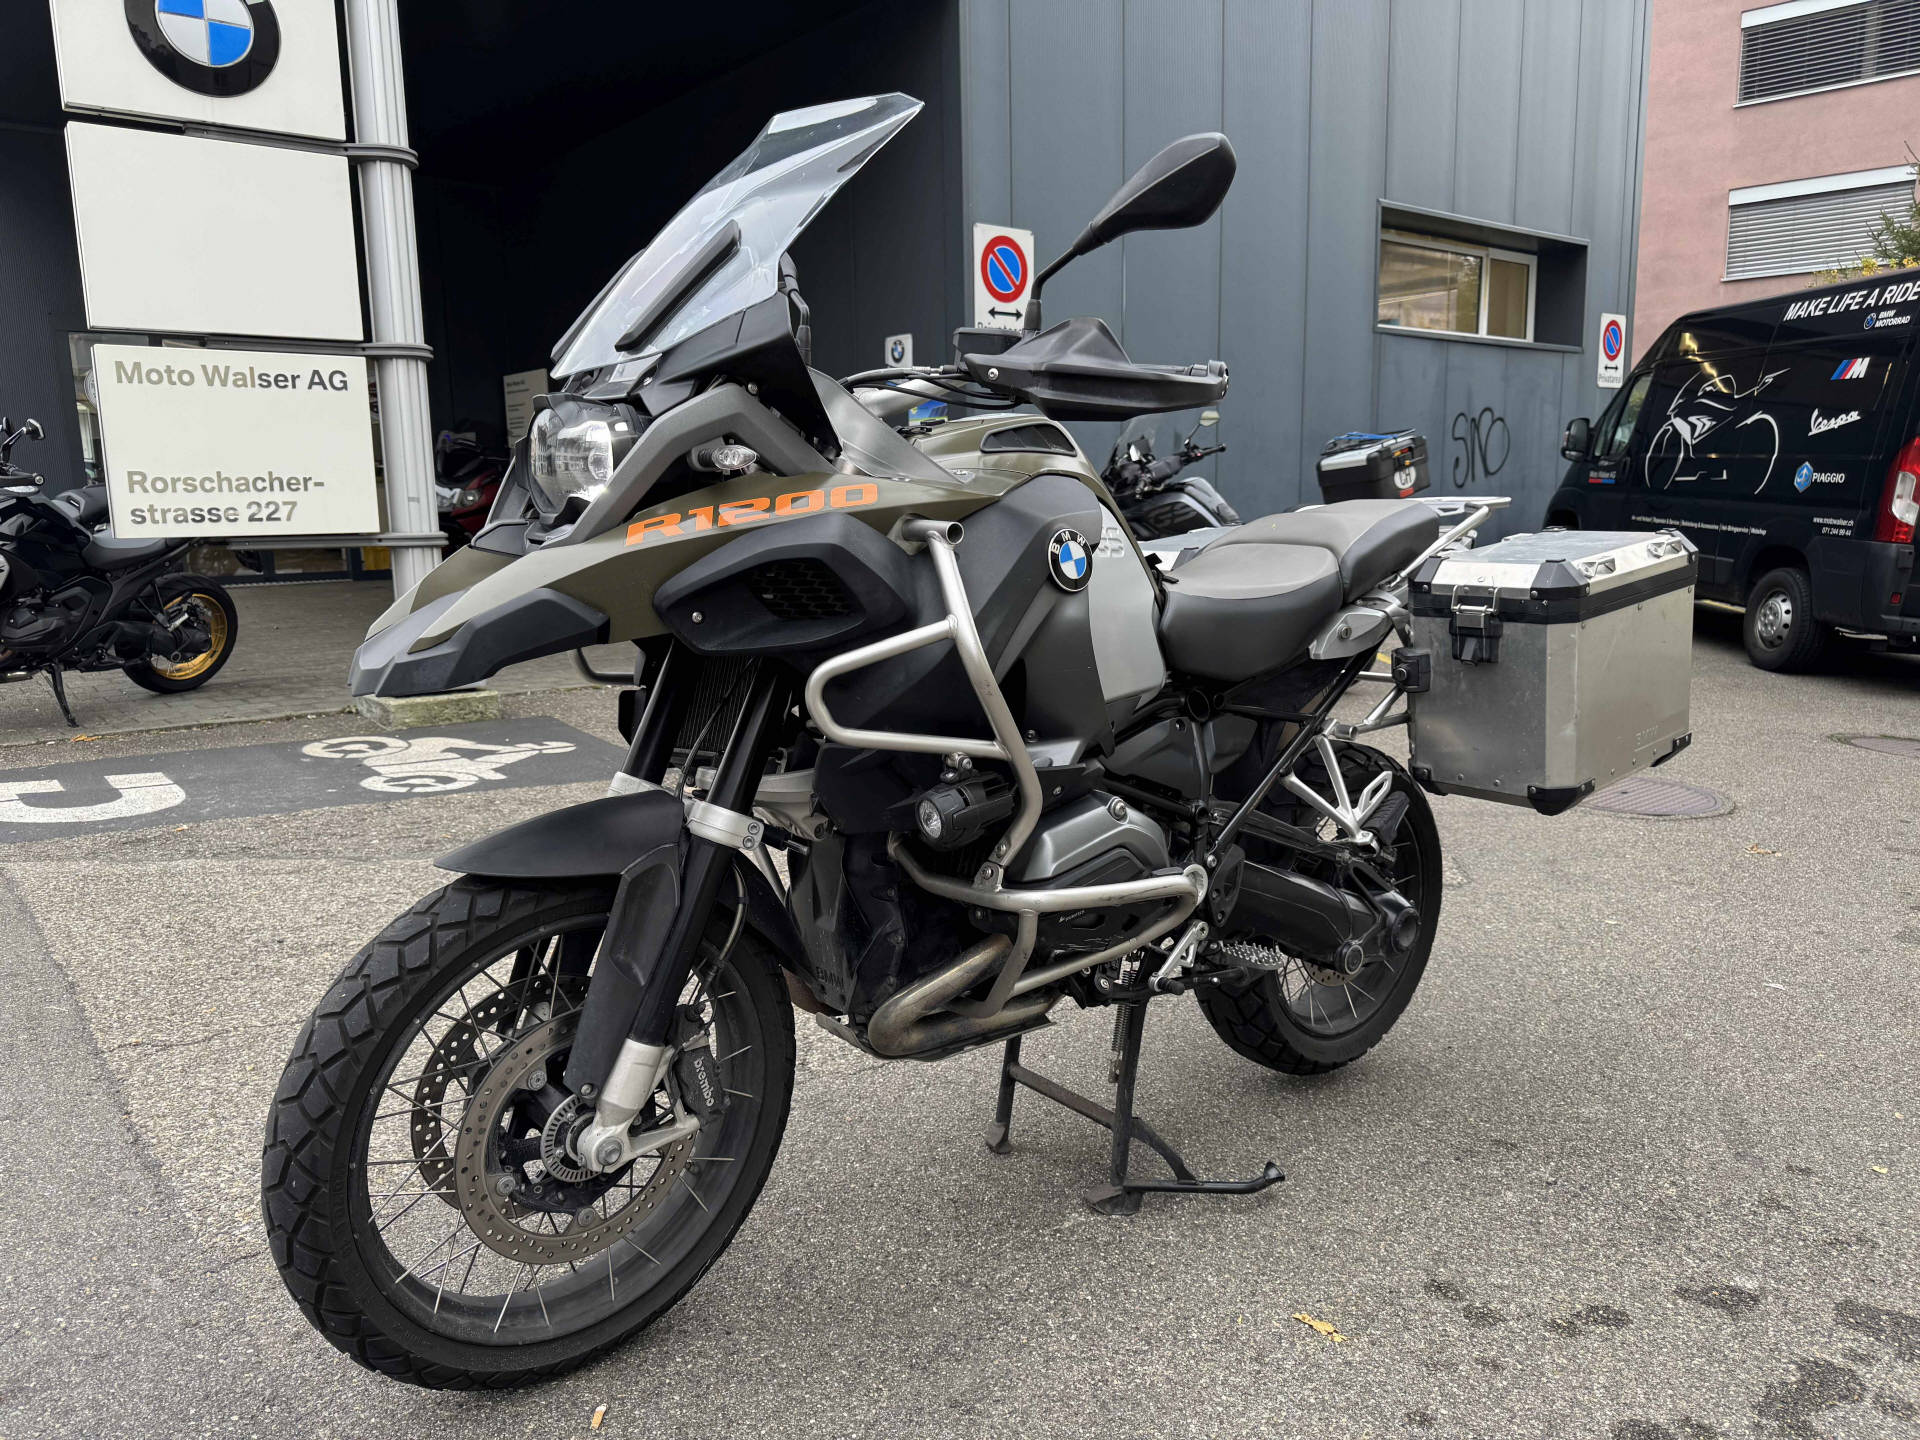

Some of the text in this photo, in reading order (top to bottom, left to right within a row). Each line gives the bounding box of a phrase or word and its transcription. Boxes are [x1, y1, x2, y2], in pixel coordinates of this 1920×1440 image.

[1783, 280, 1920, 321] MAKE LIFE A RIDE
[1874, 315, 1911, 328] MOTORRAD
[1878, 309, 1897, 319] BMW
[114, 360, 349, 391] Moto Walser AG
[1807, 407, 1862, 436] Vespa
[127, 471, 325, 494] Rorschacher-
[1812, 472, 1845, 483] PIAGGIO
[130, 501, 298, 525] strasse 227
[625, 483, 878, 546] R1200
[1051, 530, 1087, 555] BMW
[693, 1056, 715, 1107] brembo
